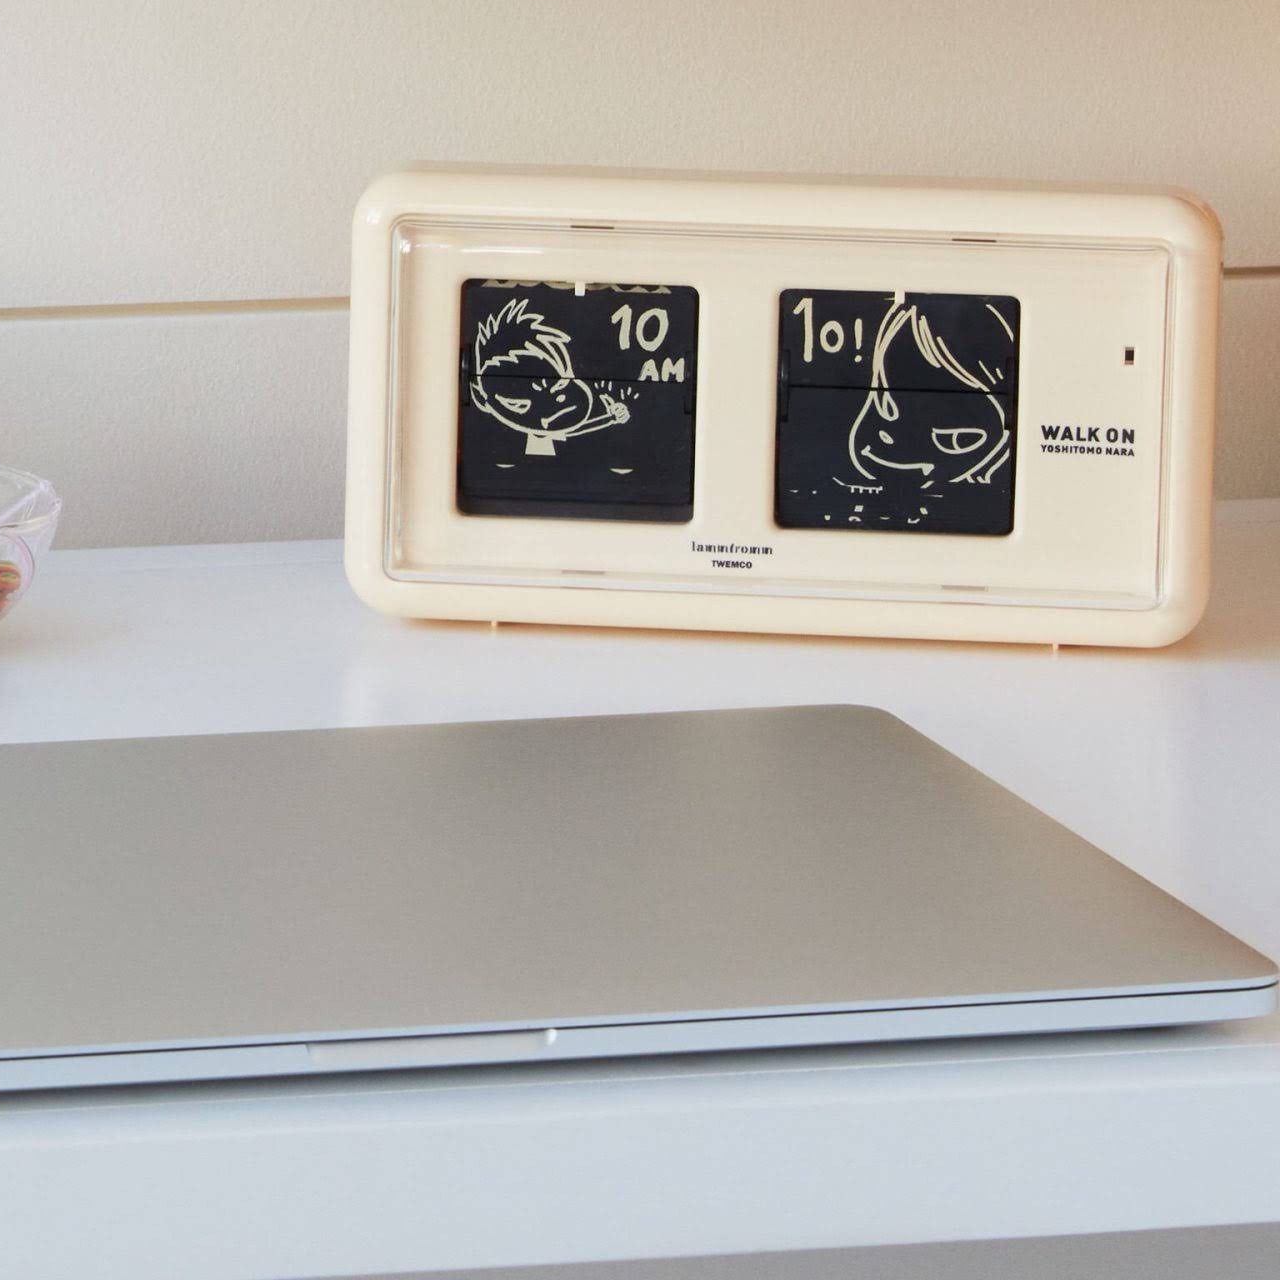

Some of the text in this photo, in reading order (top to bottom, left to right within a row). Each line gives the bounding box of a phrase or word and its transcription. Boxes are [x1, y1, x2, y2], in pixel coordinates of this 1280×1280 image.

[611, 304, 669, 352] 10
[638, 357, 685, 383] AM
[1041, 425, 1135, 444] WALK ON
[1041, 444, 1135, 457] YOSHITOMO NARA
[712, 560, 753, 569] TWEMCO
